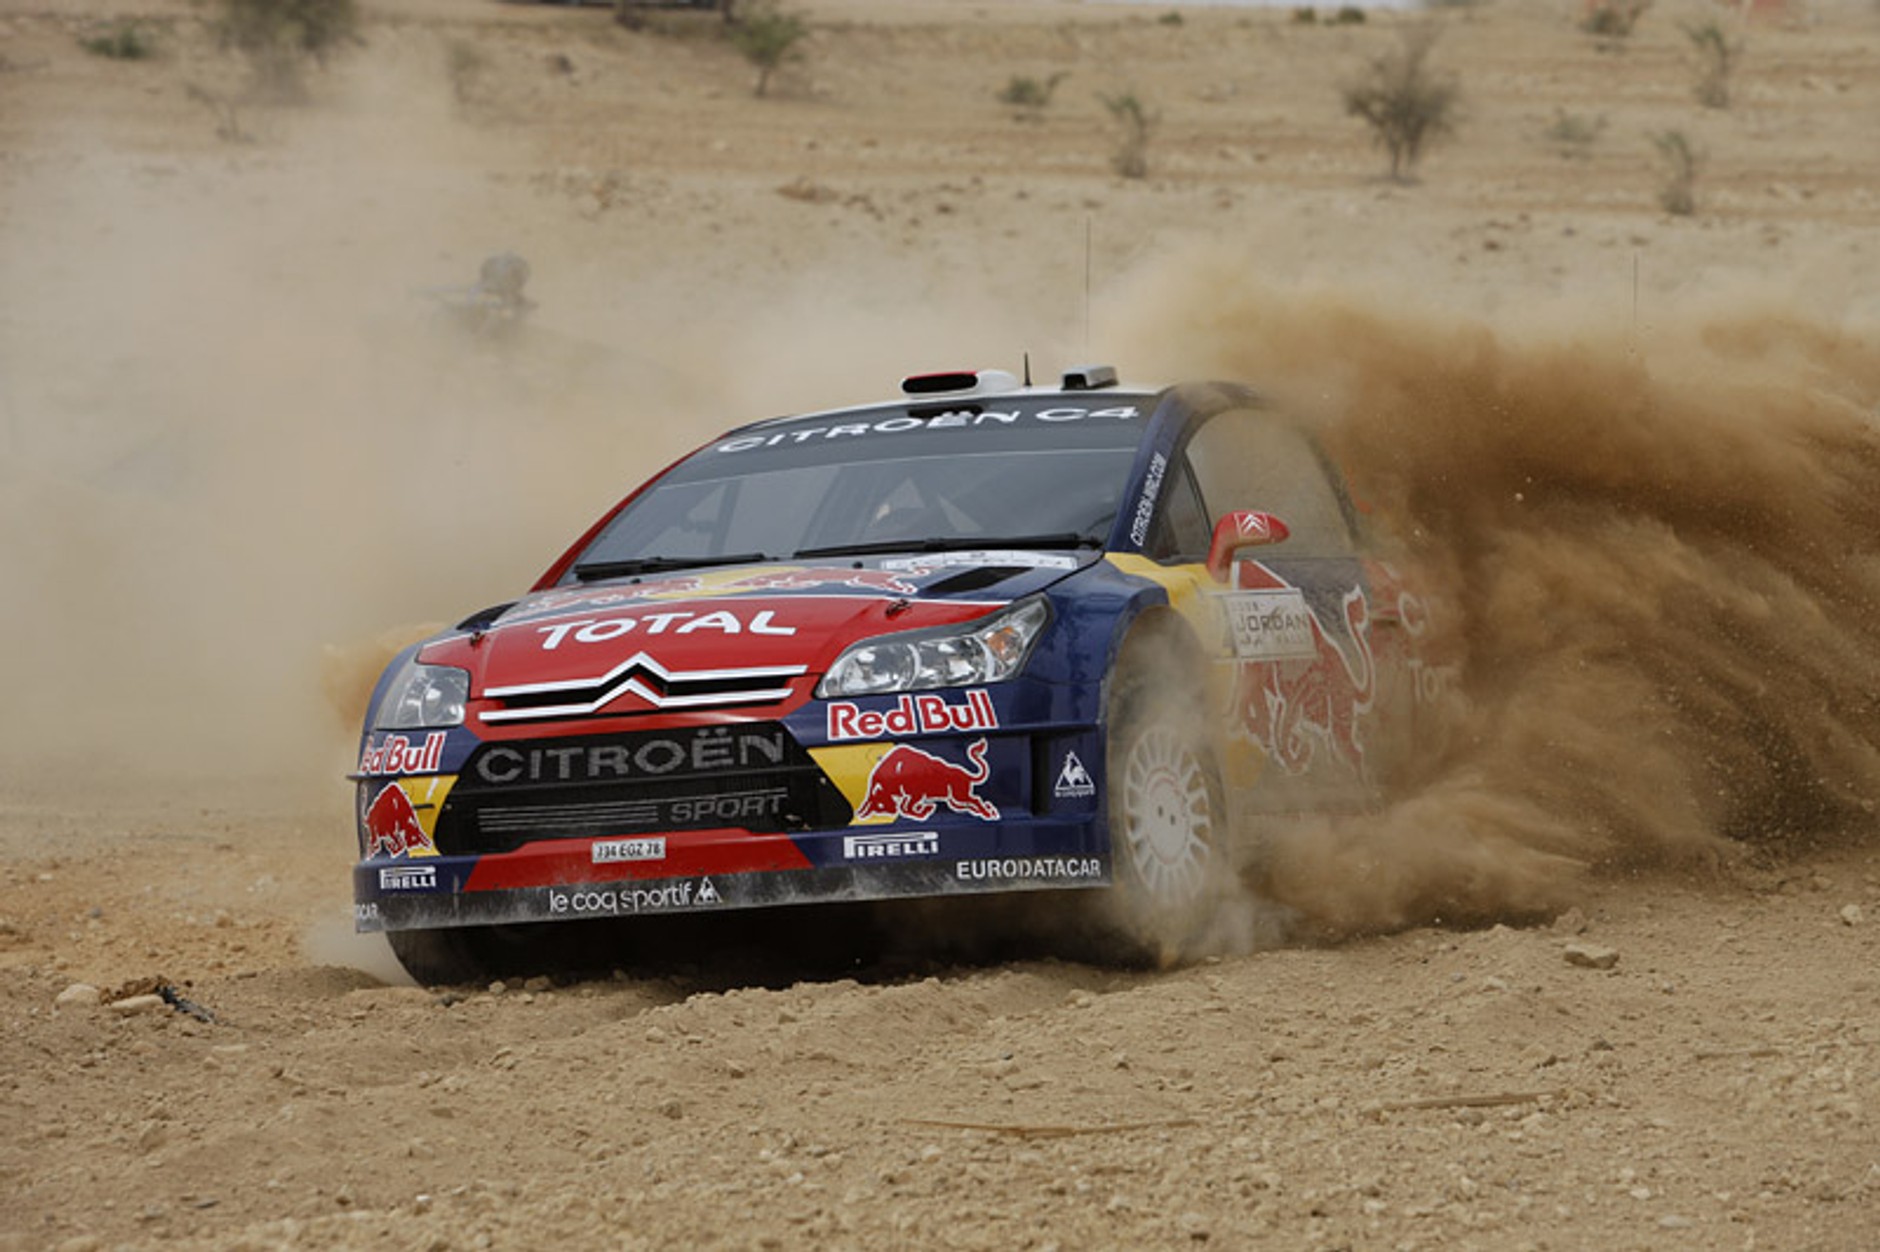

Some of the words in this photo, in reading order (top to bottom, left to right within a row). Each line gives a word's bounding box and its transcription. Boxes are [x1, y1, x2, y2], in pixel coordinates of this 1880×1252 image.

[1035, 405, 1139, 422] C4
[536, 610, 797, 650] TOTAL
[827, 695, 916, 740] Red
[915, 689, 999, 733] Bull
[384, 731, 447, 774] Bull
[476, 728, 784, 783] CITROËN
[670, 795, 788, 823] SPORT
[844, 831, 938, 858] PIRELLI
[380, 866, 436, 889] PIRELLI
[956, 857, 1101, 879] EURODATACAR
[549, 889, 568, 912] le
[572, 891, 619, 915] coq
[620, 881, 692, 912] sportif
